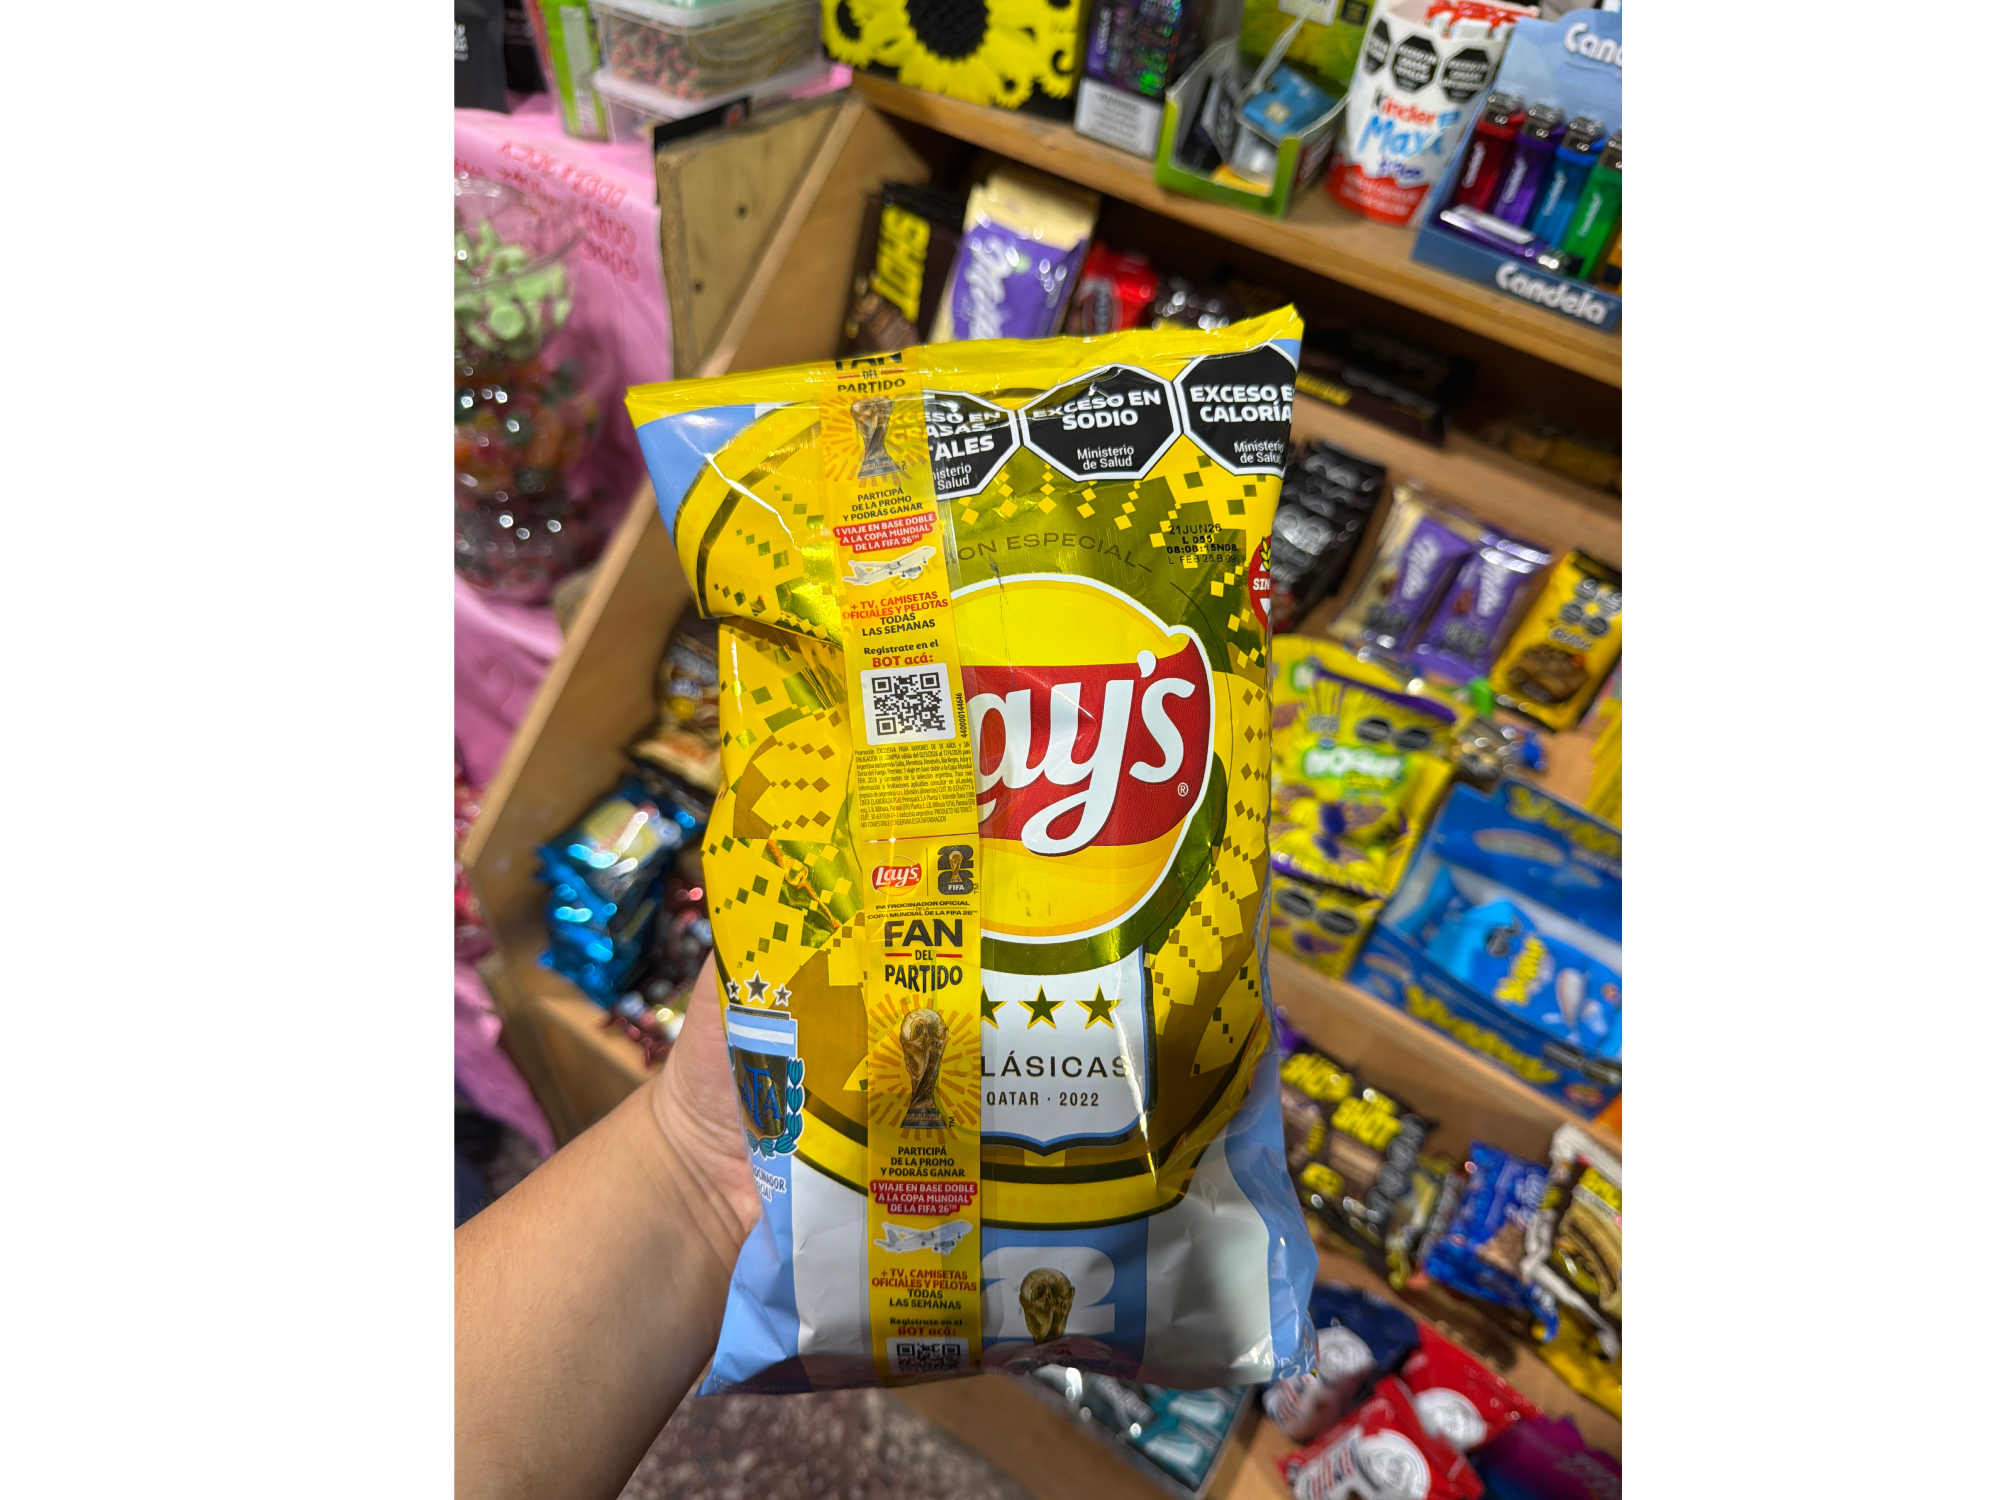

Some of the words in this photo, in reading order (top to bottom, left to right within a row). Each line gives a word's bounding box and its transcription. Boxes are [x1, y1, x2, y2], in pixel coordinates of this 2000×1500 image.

[1495, 262, 1609, 325] Candela
[862, 370, 877, 380] DEL
[837, 378, 906, 393] PARTIDO
[1190, 384, 1278, 403] EXCESO
[1280, 384, 1295, 402] E
[1032, 394, 1125, 418] EXCESO
[1128, 387, 1161, 406] EN
[968, 410, 1000, 423] EN
[1200, 399, 1292, 424] CALORÍA
[1062, 409, 1139, 430] SODIO
[1077, 443, 1134, 460] Ministerio
[1234, 438, 1284, 453] Ministerio
[1083, 460, 1097, 470] de
[1100, 456, 1132, 468] Salud
[1240, 451, 1254, 464] de
[937, 475, 970, 490] Salud
[858, 486, 904, 502] PARTICIPÁ
[851, 504, 864, 512] DE
[865, 501, 877, 510] LA
[879, 495, 912, 508] PROMO
[843, 514, 849, 522] Y
[851, 507, 888, 521] PODRÁS
[890, 502, 923, 515] GANAR
[841, 525, 867, 536] VIAJE
[868, 522, 880, 531] EN
[881, 518, 904, 530] BASE
[906, 514, 935, 526] DOBLE
[842, 536, 850, 544] A
[851, 533, 863, 543] LA
[864, 531, 888, 542] COPA
[889, 524, 930, 538] MUNDIAL
[1182, 536, 1189, 544] L
[855, 543, 867, 551] DE
[869, 541, 880, 549] LA
[882, 538, 900, 548] FIFA
[1006, 532, 1136, 569] ESPECIAL
[860, 600, 878, 610] TV,
[880, 590, 938, 607] CAMISETAS
[842, 606, 893, 620] OFICIALES
[896, 605, 902, 613] Y
[904, 599, 948, 613] PELOTAS
[880, 612, 916, 625] TODAS
[862, 626, 882, 636] LAS
[884, 619, 935, 634] SEMANAS
[864, 641, 914, 655] Registrate
[916, 641, 928, 649] en
[930, 639, 939, 648] el
[872, 656, 901, 668] BOT
[904, 652, 934, 666] acá:
[967, 649, 1196, 856] ay's
[875, 865, 919, 888] Lay's
[876, 901, 938, 910] PATROCINADOR
[890, 910, 923, 918] MUNDIAL
[884, 919, 963, 948] FAN
[915, 949, 933, 961] DEL
[885, 964, 963, 993] PARTIDO
[980, 1050, 1129, 1078] LÁSICAS
[986, 1091, 1039, 1106] QATAR
[1059, 1091, 1099, 1107] 2022
[898, 1145, 947, 1156] PARTICIPÁ
[891, 1157, 903, 1165] DE
[905, 1158, 917, 1166] LA
[919, 1158, 954, 1166] PROMO
[880, 1167, 887, 1175] Y
[889, 1166, 928, 1177] PODRÁS
[930, 1168, 965, 1177] GANAR
[872, 1183, 877, 1191] 1
[878, 1183, 904, 1192] VIAJE
[906, 1183, 917, 1192] EN
[920, 1184, 943, 1193] BASE
[944, 1184, 974, 1192] DOBLE
[878, 1193, 885, 1201] A
[887, 1194, 899, 1202] LA
[900, 1194, 925, 1202] COPA
[926, 1195, 969, 1203] MUNDIAL
[890, 1204, 902, 1212] DE
[904, 1204, 916, 1213] LA
[918, 1205, 936, 1213] FIFA
[890, 1268, 907, 1278] TV,
[910, 1269, 968, 1280] CAMISETAS
[872, 1277, 922, 1288] OFICIALES
[924, 1279, 931, 1288] Y
[933, 1280, 977, 1291] PELOTAS
[907, 1288, 943, 1299] TODAS
[889, 1298, 909, 1307] LAS
[911, 1299, 962, 1309] SEMANAS
[890, 1317, 938, 1326] Registrate
[940, 1318, 953, 1326] en
[955, 1317, 962, 1326] el
[898, 1327, 924, 1337] BOT
